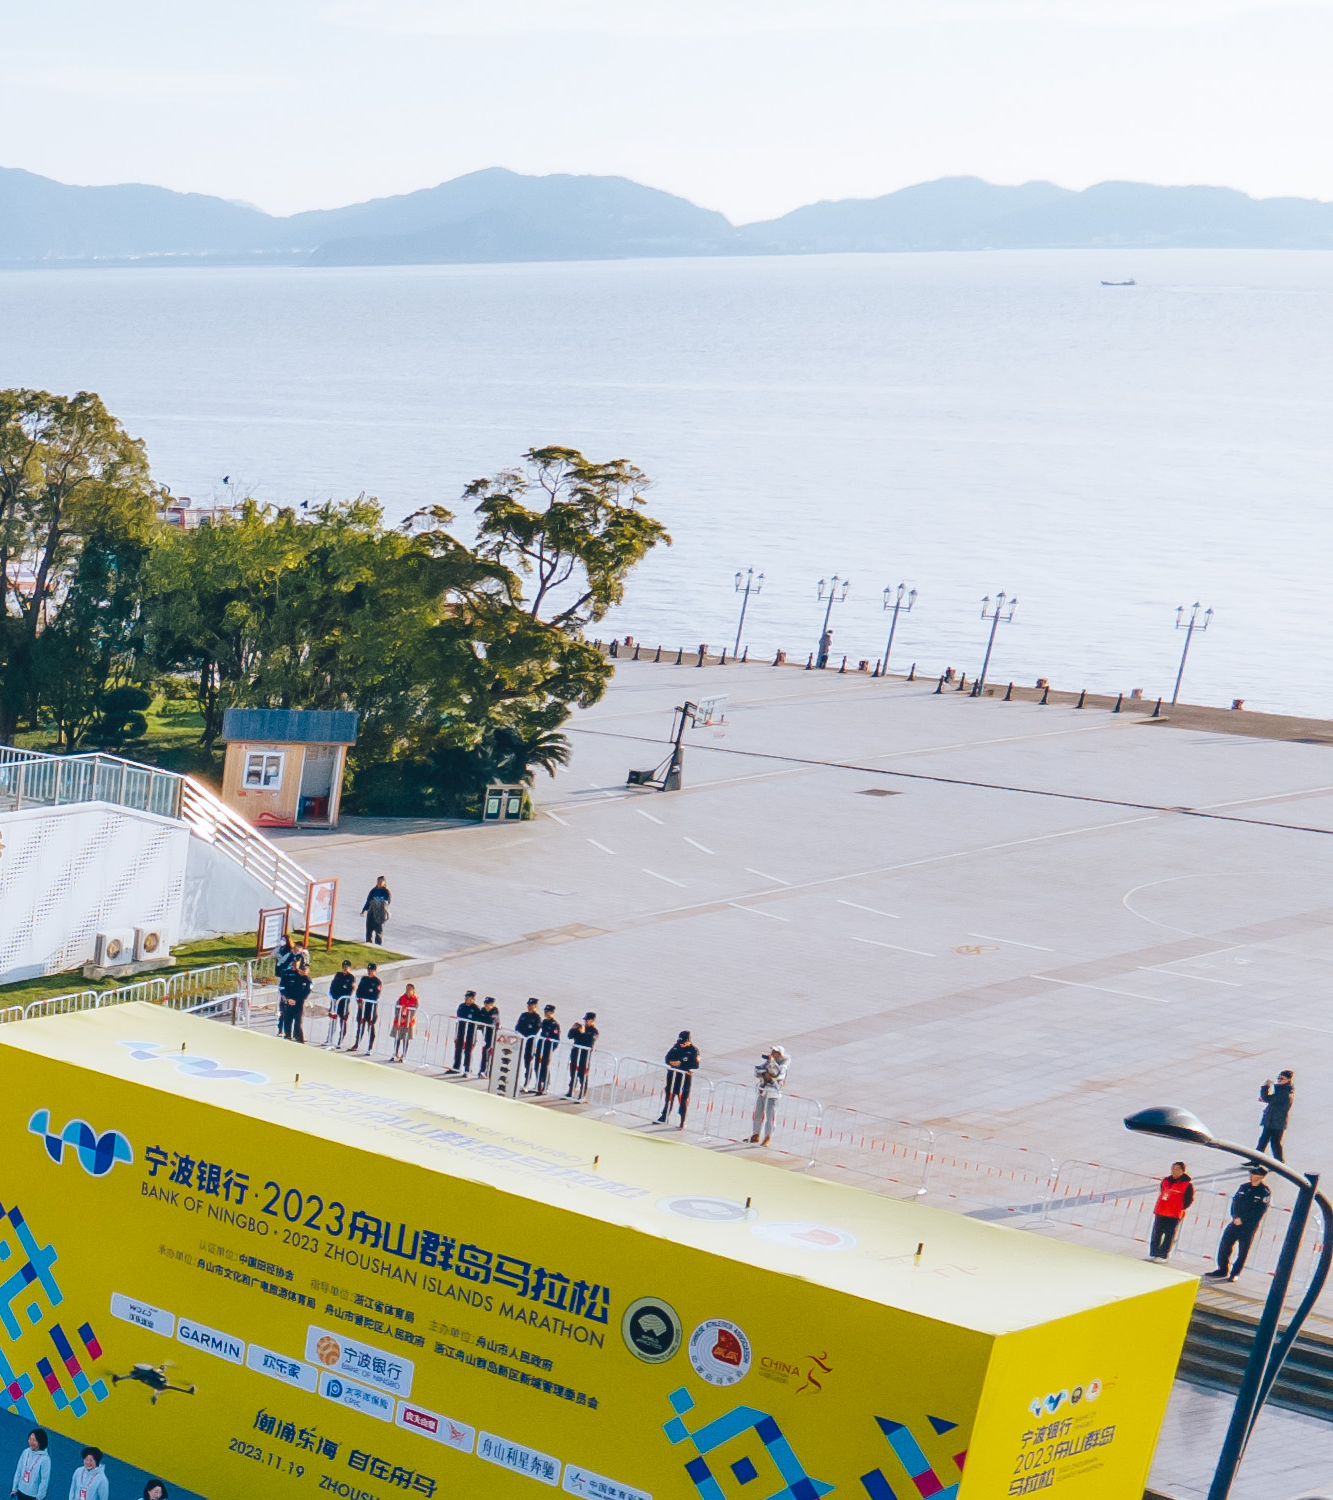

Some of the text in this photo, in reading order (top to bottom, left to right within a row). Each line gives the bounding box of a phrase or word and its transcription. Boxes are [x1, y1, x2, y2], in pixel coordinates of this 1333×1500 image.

[141, 1181, 179, 1206] BANK
[183, 1196, 203, 1214] OF
[207, 1203, 269, 1236] NINGBO
[283, 1229, 319, 1254] 2023
[324, 1242, 418, 1287] ZHOUSHAN
[422, 1275, 494, 1312] ISLANDS
[498, 1301, 605, 1349] MARATHON
[180, 1325, 240, 1359] GARMIN
[263, 1353, 301, 1380] 欢乐家
[344, 1347, 402, 1381] 宁波银行
[760, 1356, 800, 1377] CHINA
[1013, 1425, 1116, 1475] 2023舟山群岛
[1021, 1417, 1074, 1449] 宁波银行
[229, 1437, 305, 1478] 2023.11.19
[1007, 1467, 1056, 1496] 马拉松
